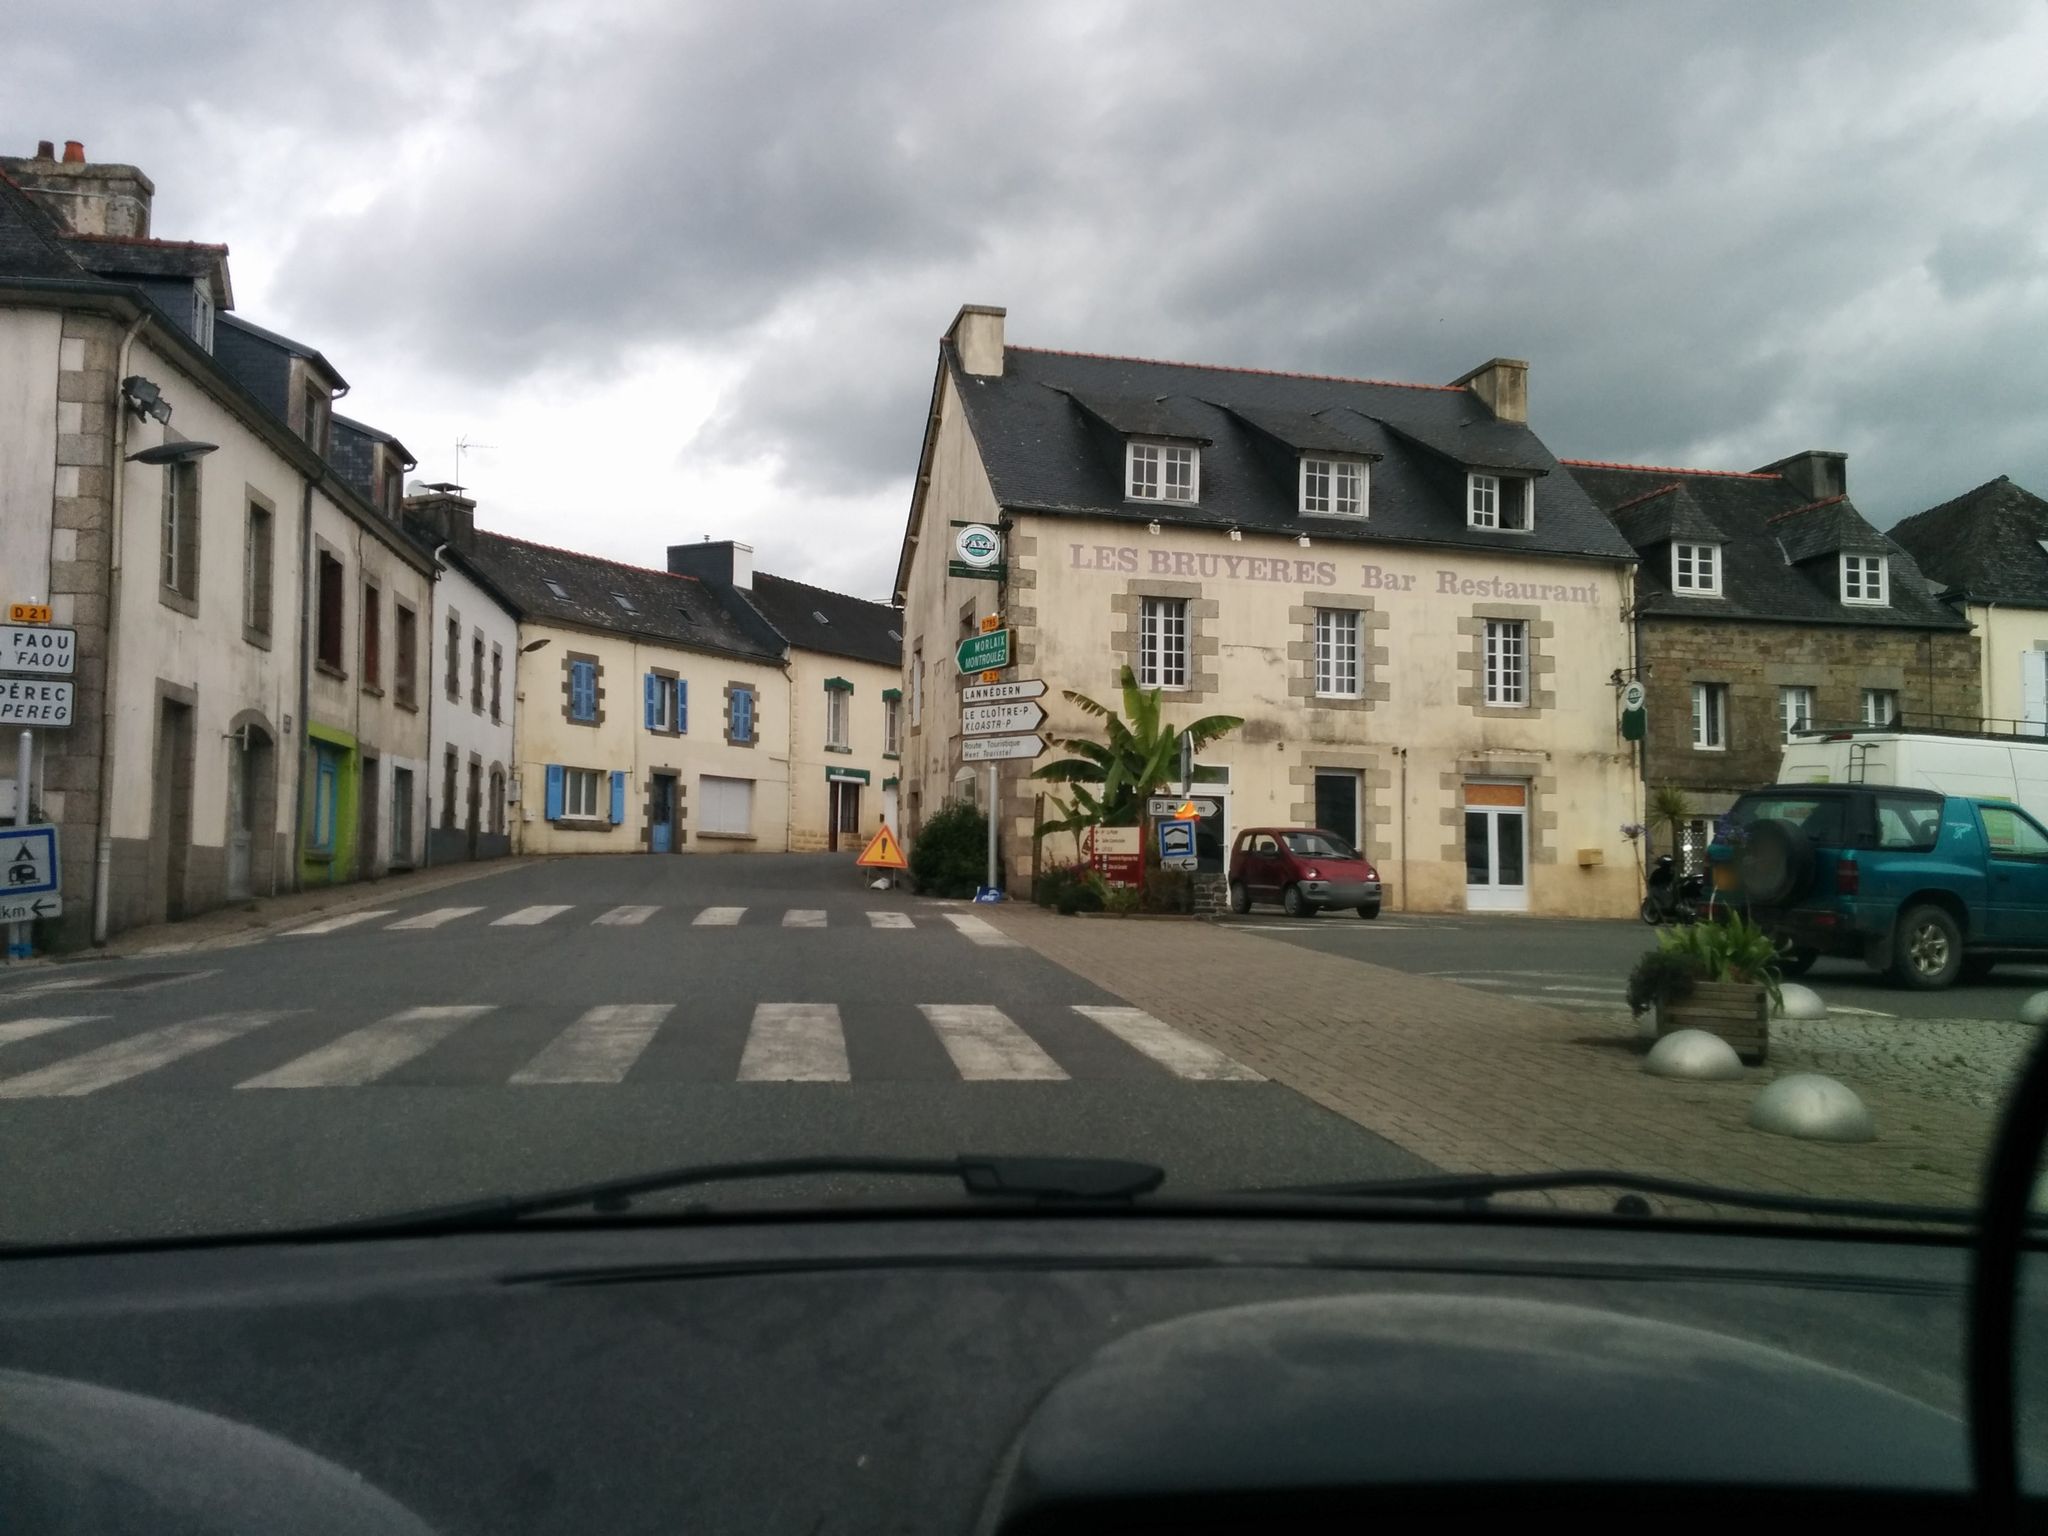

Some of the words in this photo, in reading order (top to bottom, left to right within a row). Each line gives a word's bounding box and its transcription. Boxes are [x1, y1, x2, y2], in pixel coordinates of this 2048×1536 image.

[1069, 544, 1139, 573] LES
[1147, 549, 1337, 586] BRUYERES
[1361, 564, 1416, 592] Bar
[1436, 570, 1600, 605] Restaurant
[29, 608, 47, 619] 21
[13, 633, 69, 649] FAOU
[974, 635, 1005, 653] MORLAIX
[17, 651, 70, 668] FAOU
[964, 649, 1006, 669] MONTROULEZ
[965, 685, 1021, 700] LANNÉDERN
[1, 703, 67, 720] PEREG
[965, 710, 975, 720] LE
[964, 742, 982, 750] Route
[0, 905, 26, 918] km
